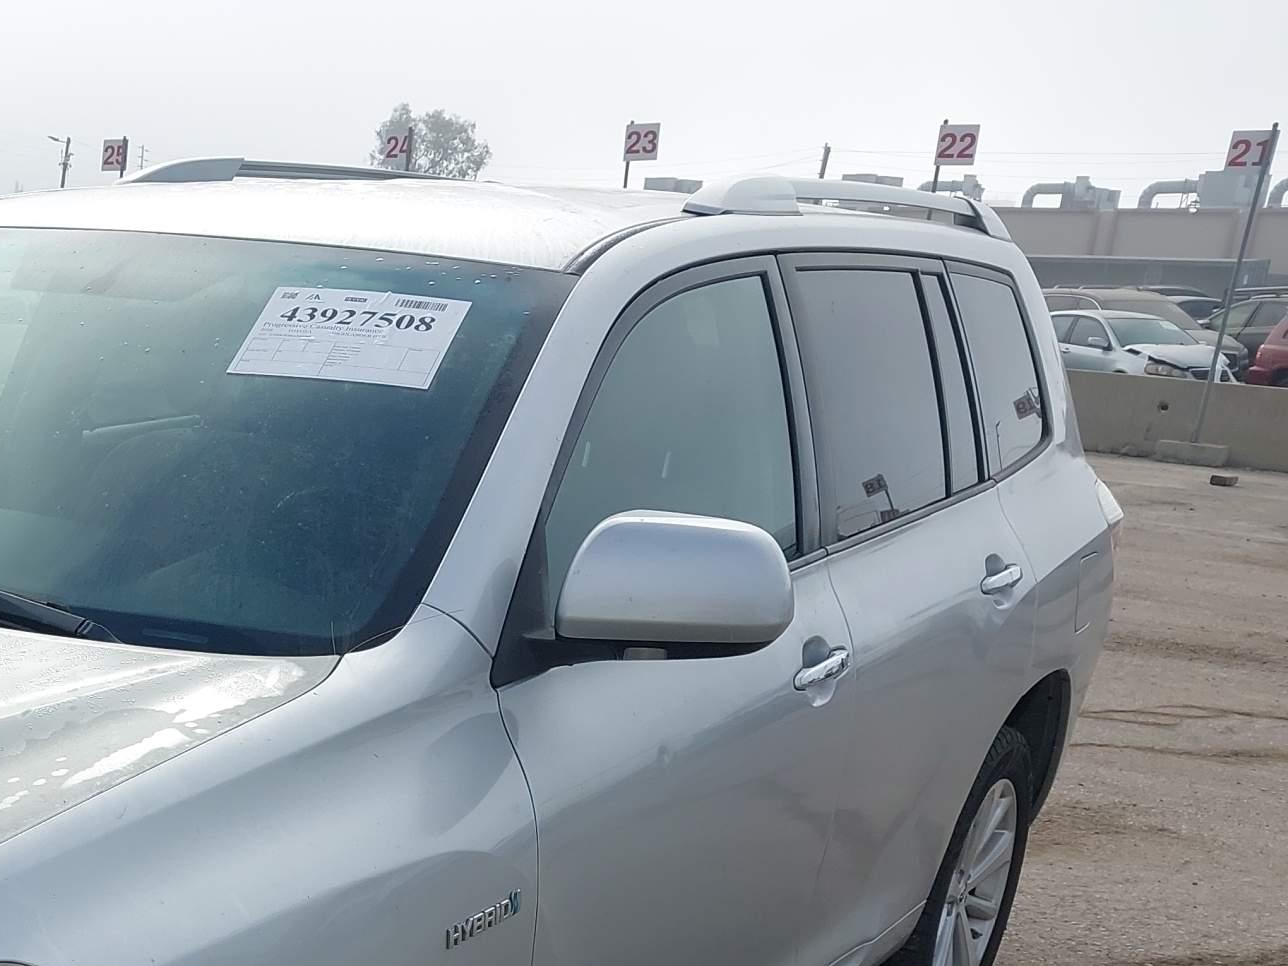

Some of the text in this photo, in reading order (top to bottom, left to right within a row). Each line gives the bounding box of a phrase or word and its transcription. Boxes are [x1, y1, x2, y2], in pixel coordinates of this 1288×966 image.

[386, 135, 409, 158] 24
[625, 130, 657, 154] 23
[937, 132, 977, 158] 22
[1228, 139, 1271, 167] 21
[280, 306, 436, 332] 43927508
[445, 898, 510, 950] HYBRID
